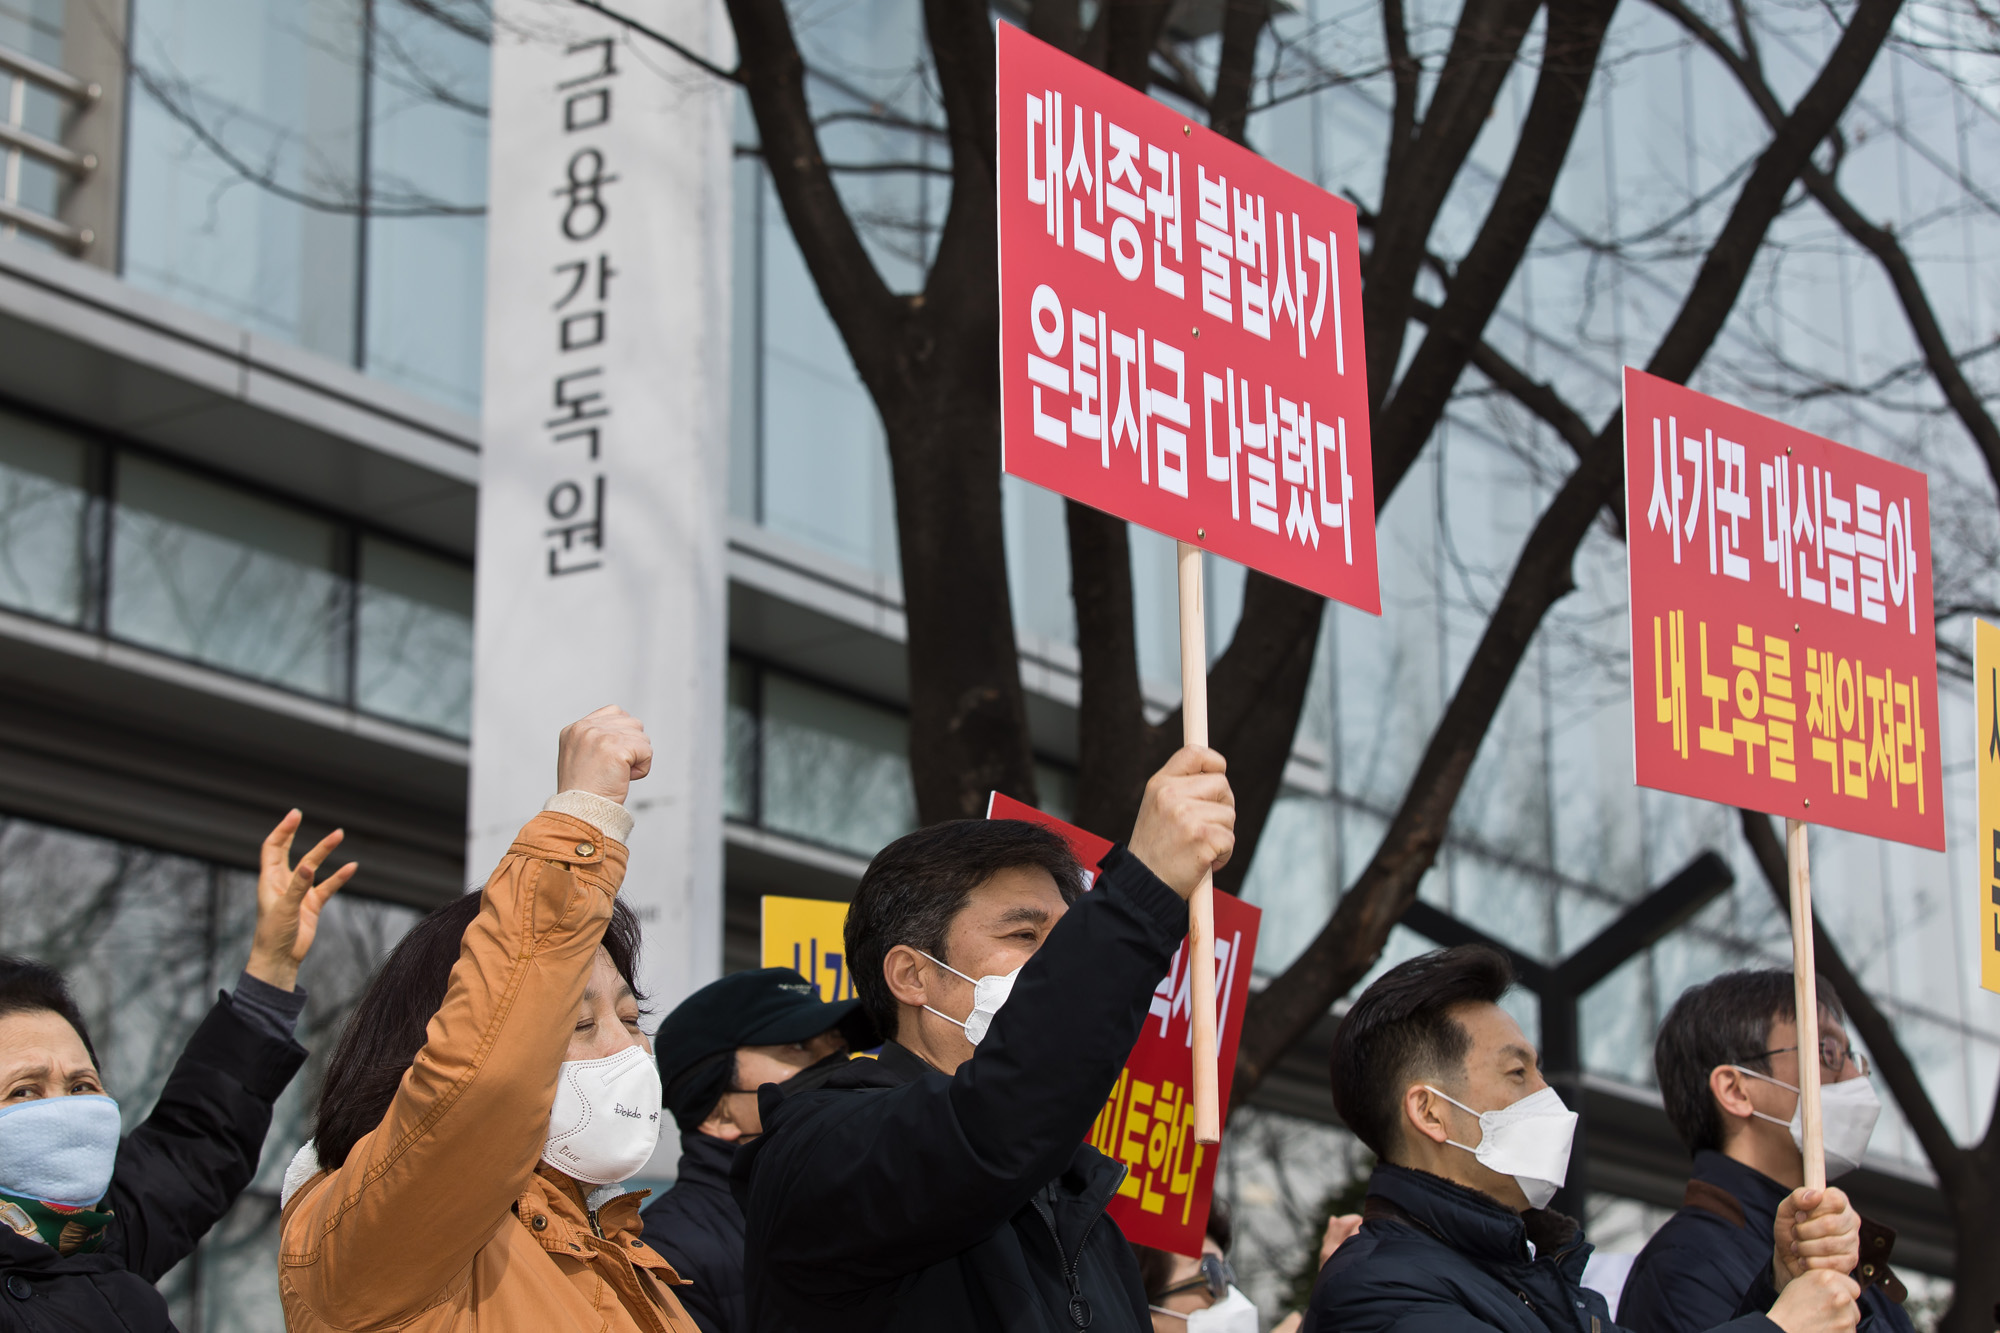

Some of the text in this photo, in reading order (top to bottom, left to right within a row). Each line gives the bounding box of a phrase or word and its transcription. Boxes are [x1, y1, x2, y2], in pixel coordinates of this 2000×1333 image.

[544, 37, 620, 578] 금융감독원
[1026, 89, 1345, 377] 대신증권 불법사기
[1027, 284, 1354, 566] 은퇴자금 다날렸다
[1647, 415, 1917, 635] 사기꾼 대신놈들아
[1654, 609, 1689, 760] 내
[1699, 621, 1797, 784] 노후를
[1805, 648, 1926, 815] 책임져라
